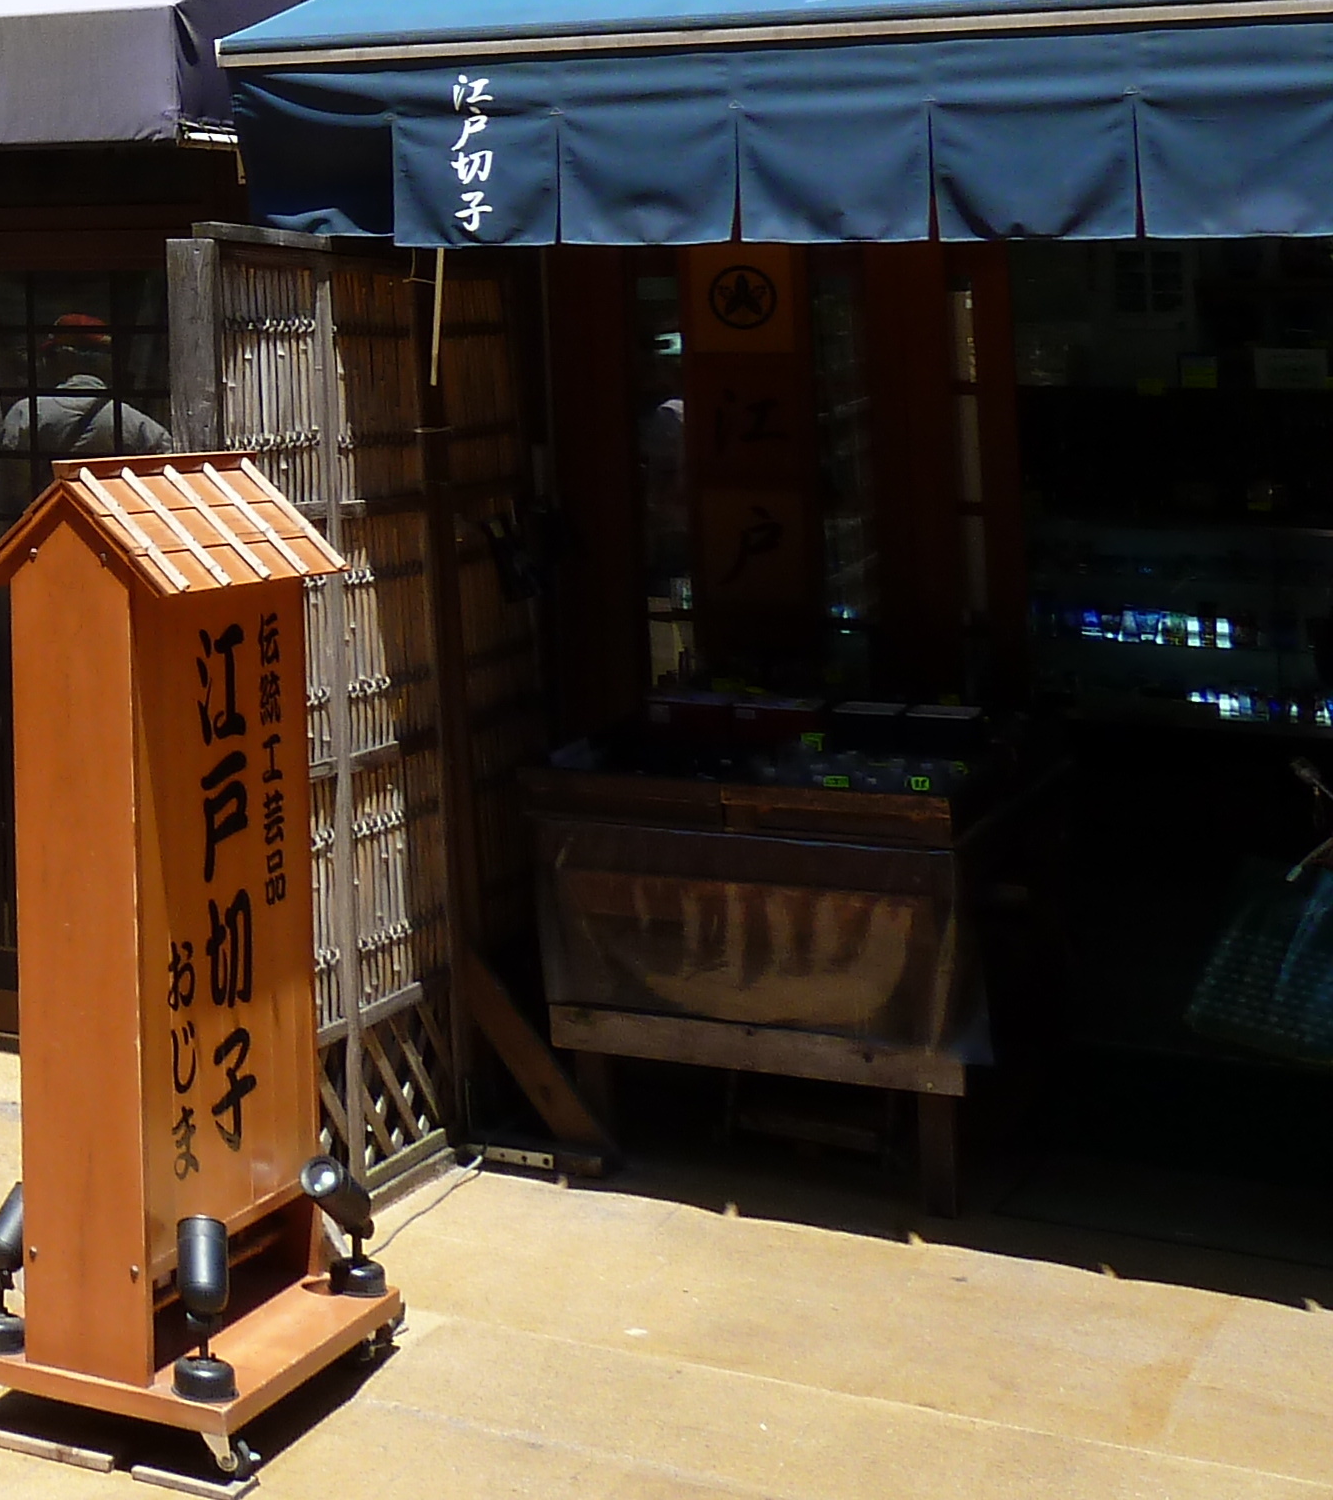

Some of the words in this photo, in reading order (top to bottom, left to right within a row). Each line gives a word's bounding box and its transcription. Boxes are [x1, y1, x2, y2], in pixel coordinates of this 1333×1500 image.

[449, 74, 493, 232] 江戸切子
[197, 622, 259, 1152] 江戸切子
[258, 611, 287, 906] 伝統工芸品
[167, 940, 200, 1182] おじま
